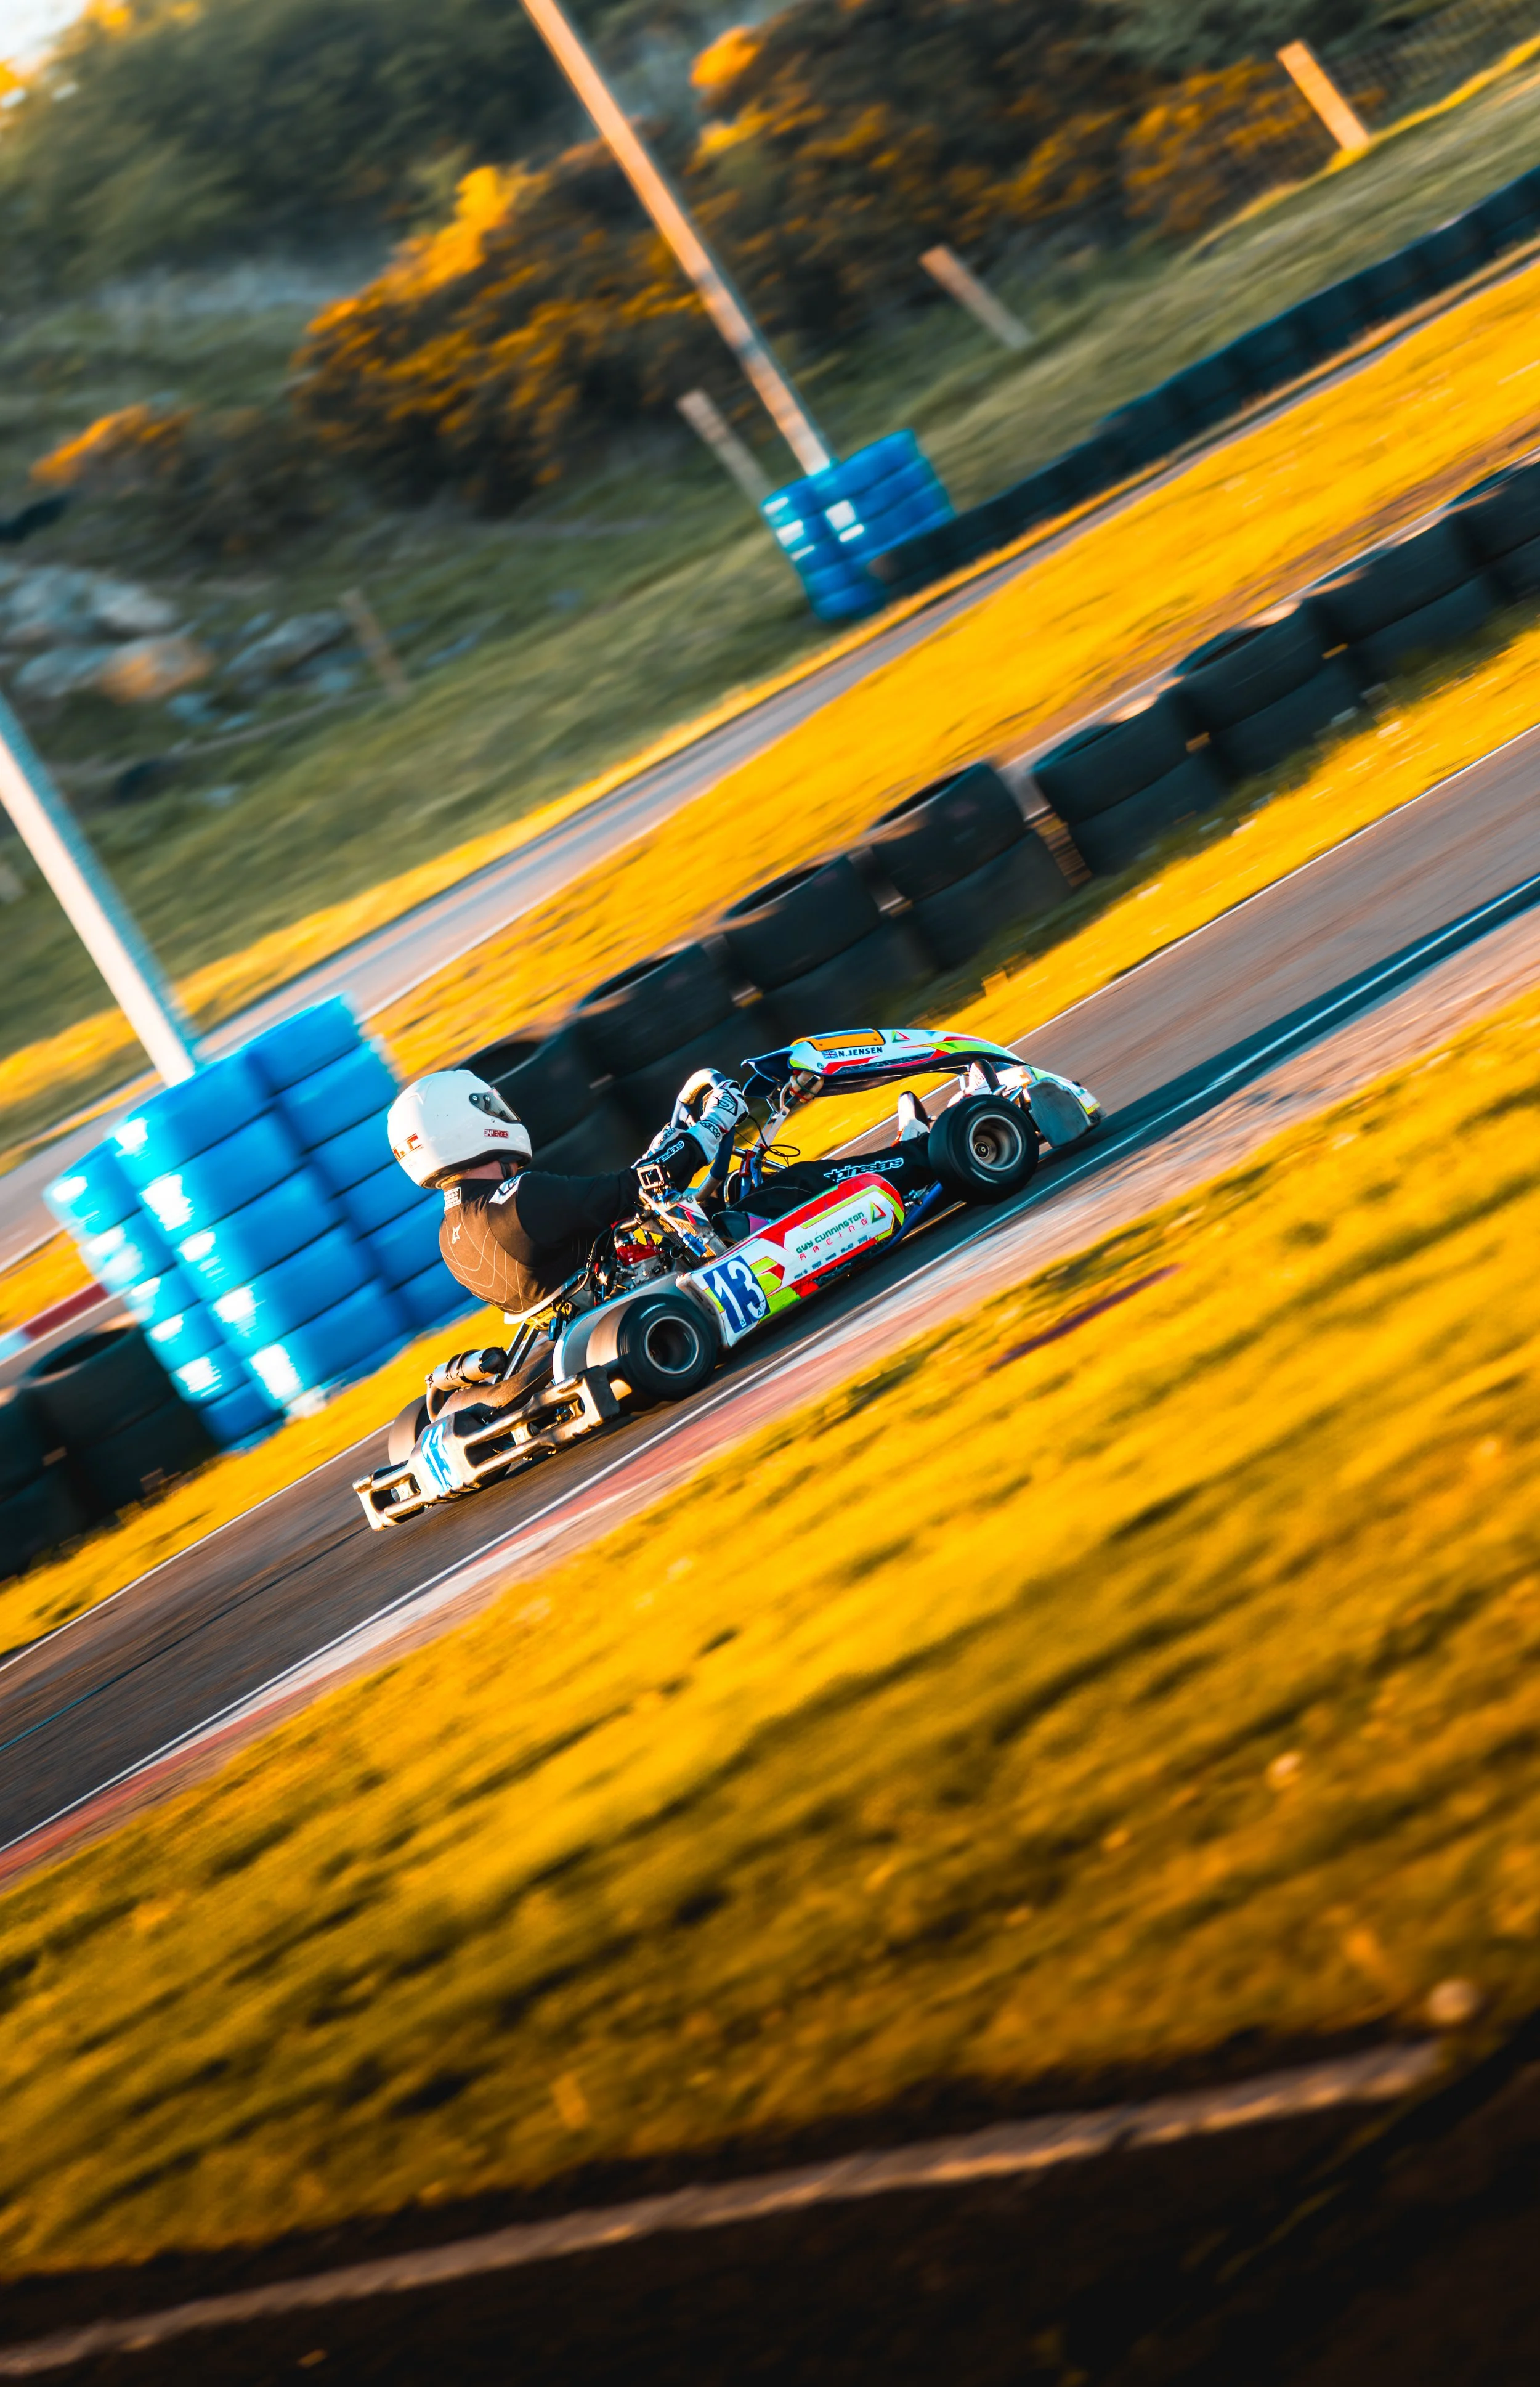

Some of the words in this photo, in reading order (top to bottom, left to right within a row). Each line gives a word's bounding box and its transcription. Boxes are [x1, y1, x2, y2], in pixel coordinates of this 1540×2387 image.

[838, 1046, 883, 1057] N.JENSEN
[699, 1120, 721, 1139] arco
[814, 1211, 865, 1243] CUNNINGTON
[712, 1260, 766, 1328] 13
